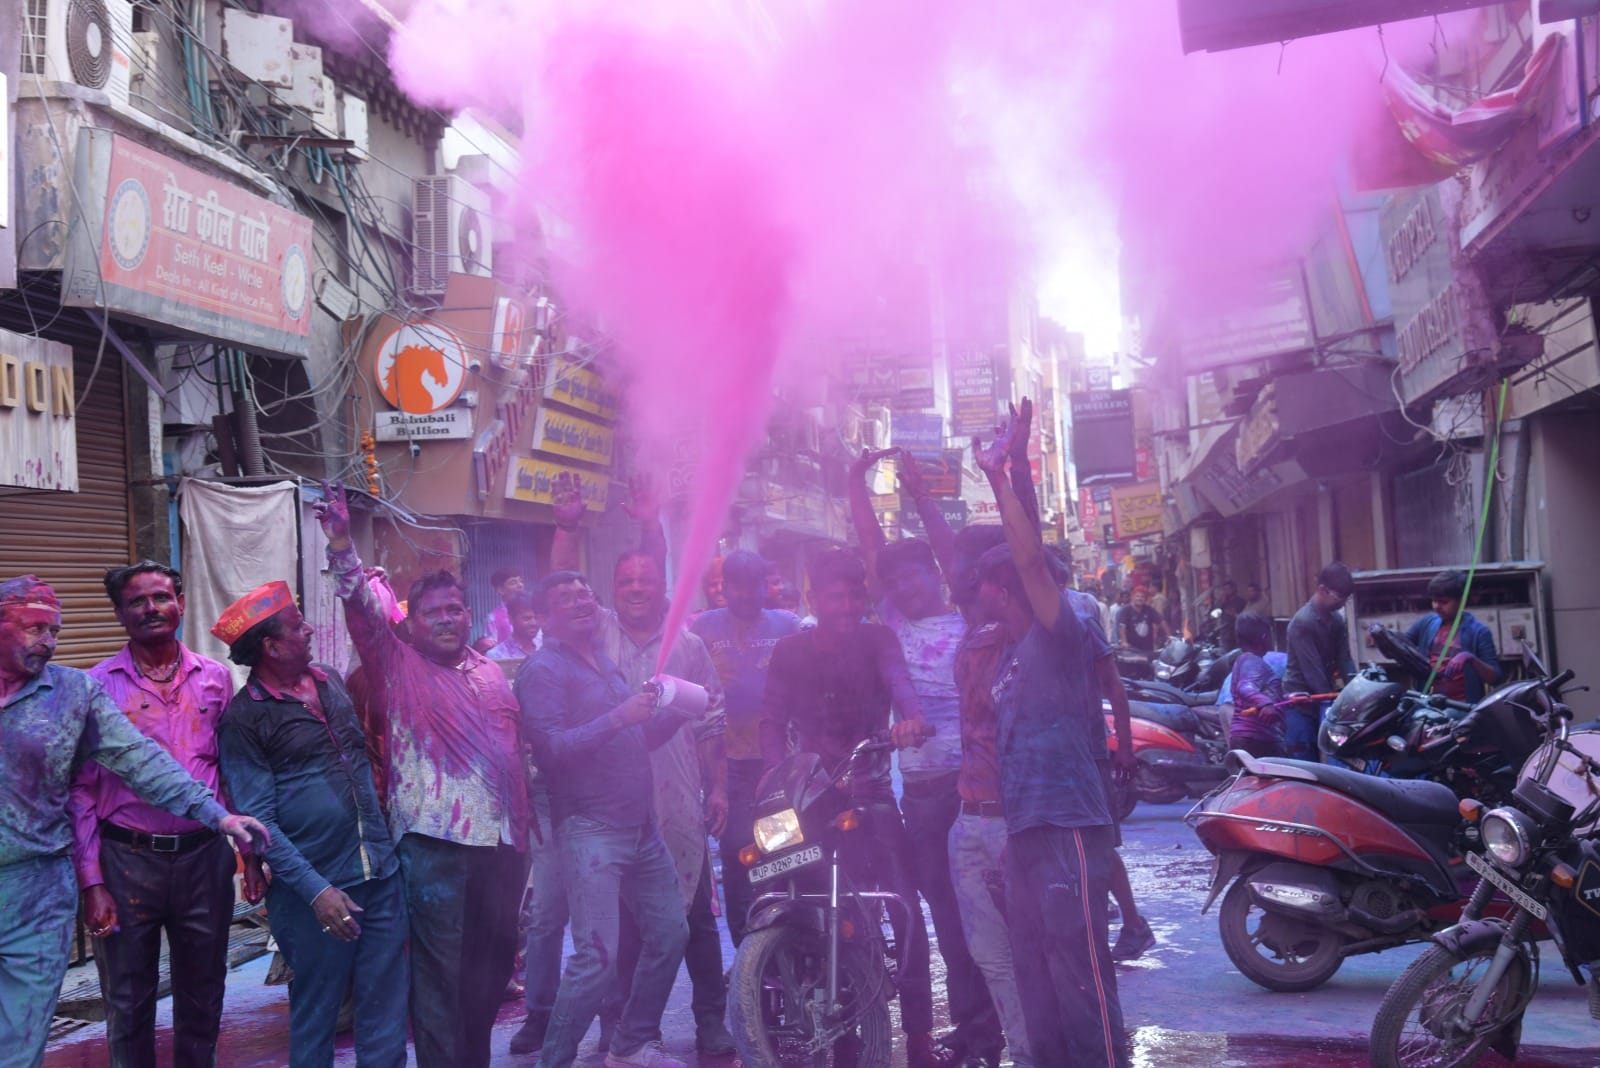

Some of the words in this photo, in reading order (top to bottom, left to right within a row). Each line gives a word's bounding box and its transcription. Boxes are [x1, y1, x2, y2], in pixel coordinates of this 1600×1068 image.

[162, 171, 193, 234] सेठ
[196, 189, 236, 251] कील
[239, 210, 271, 264] वाले
[175, 243, 200, 267] Seth
[203, 252, 227, 277] Keel
[389, 413, 457, 425] Bahubali
[1583, 888, 1600, 900] TV
